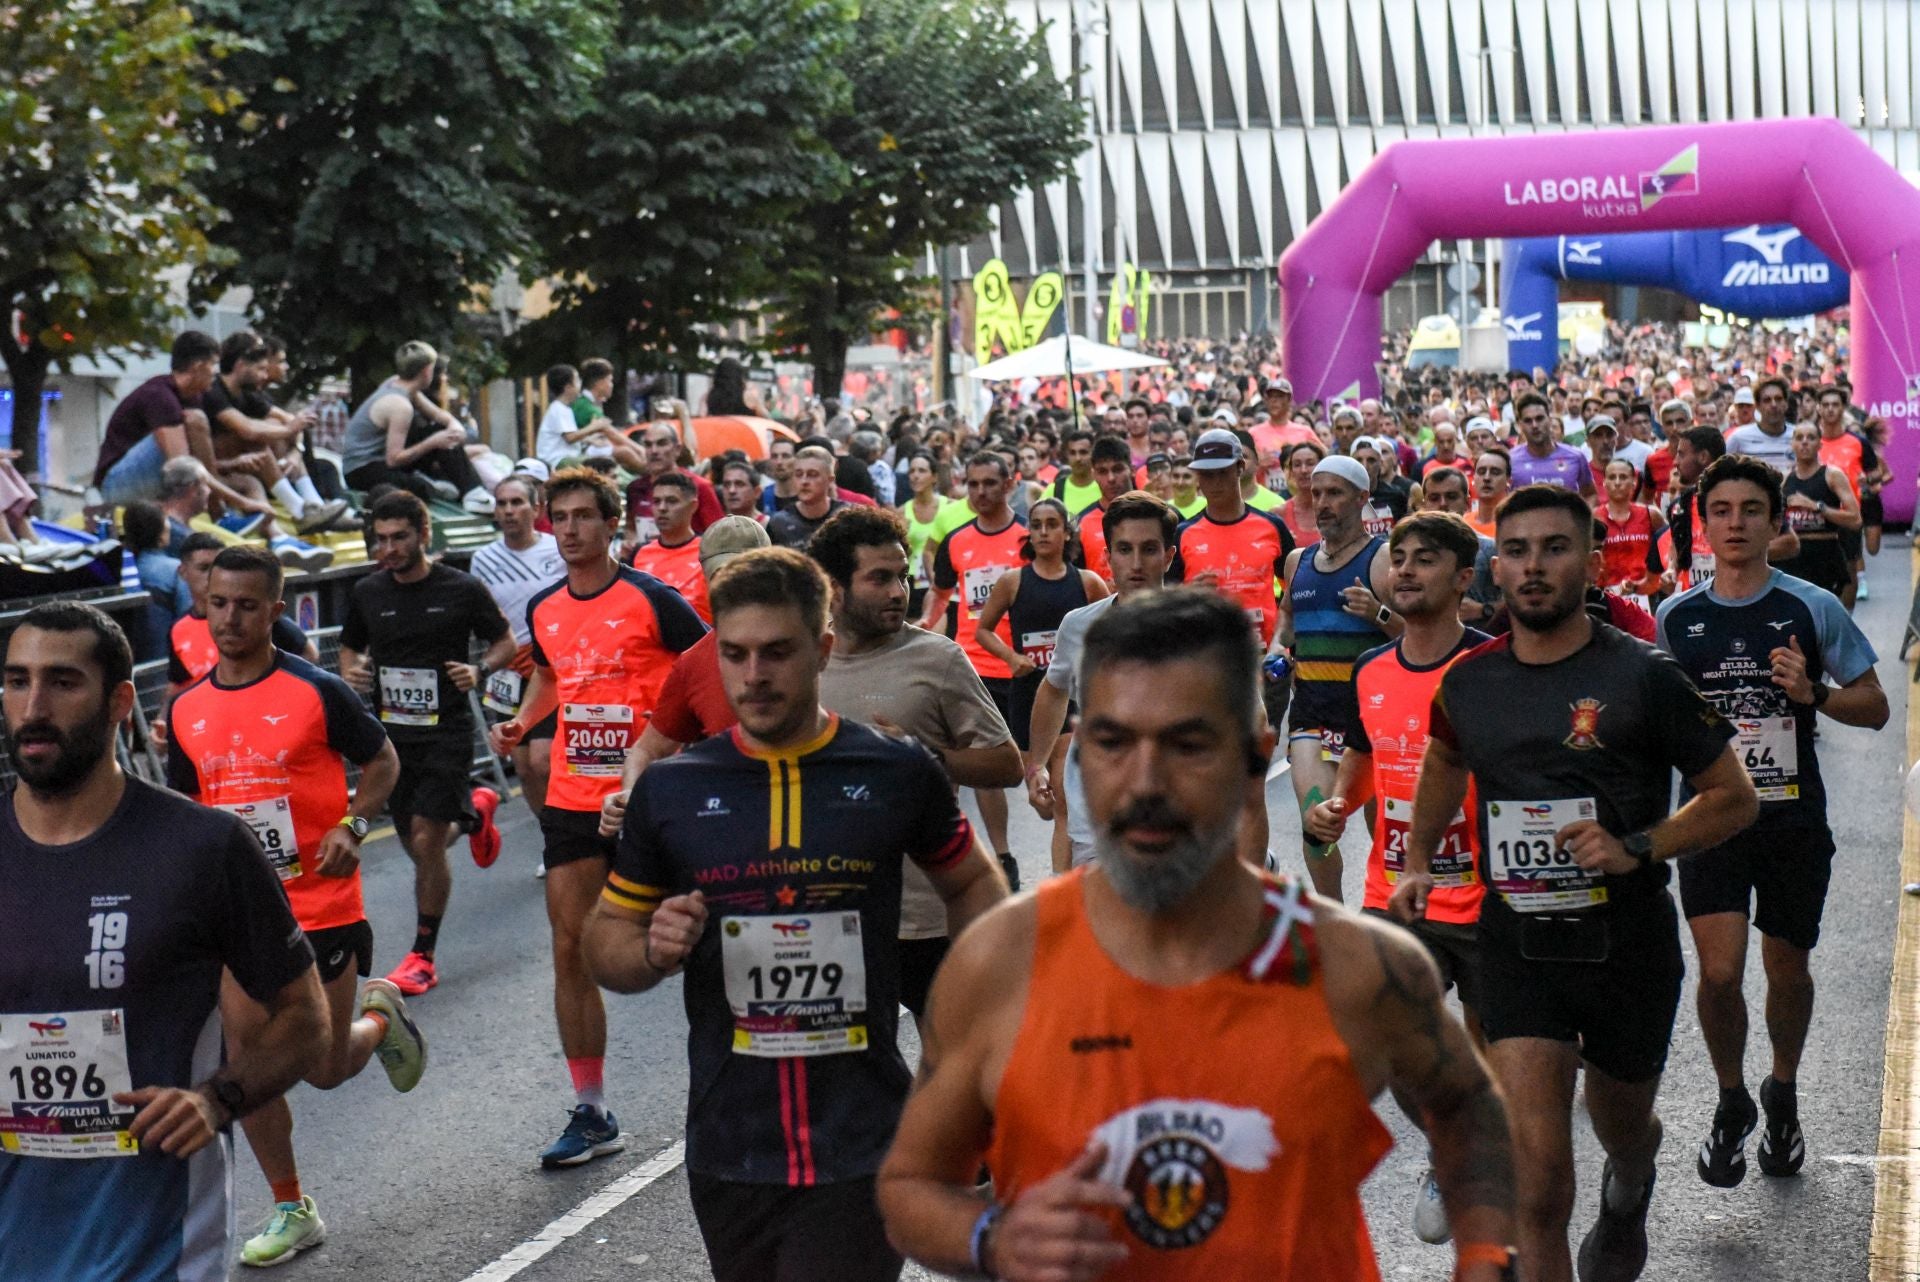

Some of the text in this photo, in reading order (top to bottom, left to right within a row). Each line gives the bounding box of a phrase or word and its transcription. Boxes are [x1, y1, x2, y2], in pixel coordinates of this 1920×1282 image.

[1503, 174, 1637, 206] LABORAL
[1582, 201, 1639, 219] kutxa
[1703, 669, 1775, 679] NIGHT MARATHO
[386, 686, 434, 703] 11938
[568, 728, 629, 748] 20607
[745, 857, 822, 879] Athlete
[826, 854, 876, 874] Crew
[88, 911, 128, 951] 19
[774, 950, 812, 960] GOMEZ
[84, 950, 125, 989] 16
[747, 962, 844, 1000] 1979
[25, 1050, 77, 1061] LUNATICO
[9, 1063, 106, 1101] 1896
[74, 1119, 88, 1129] LA
